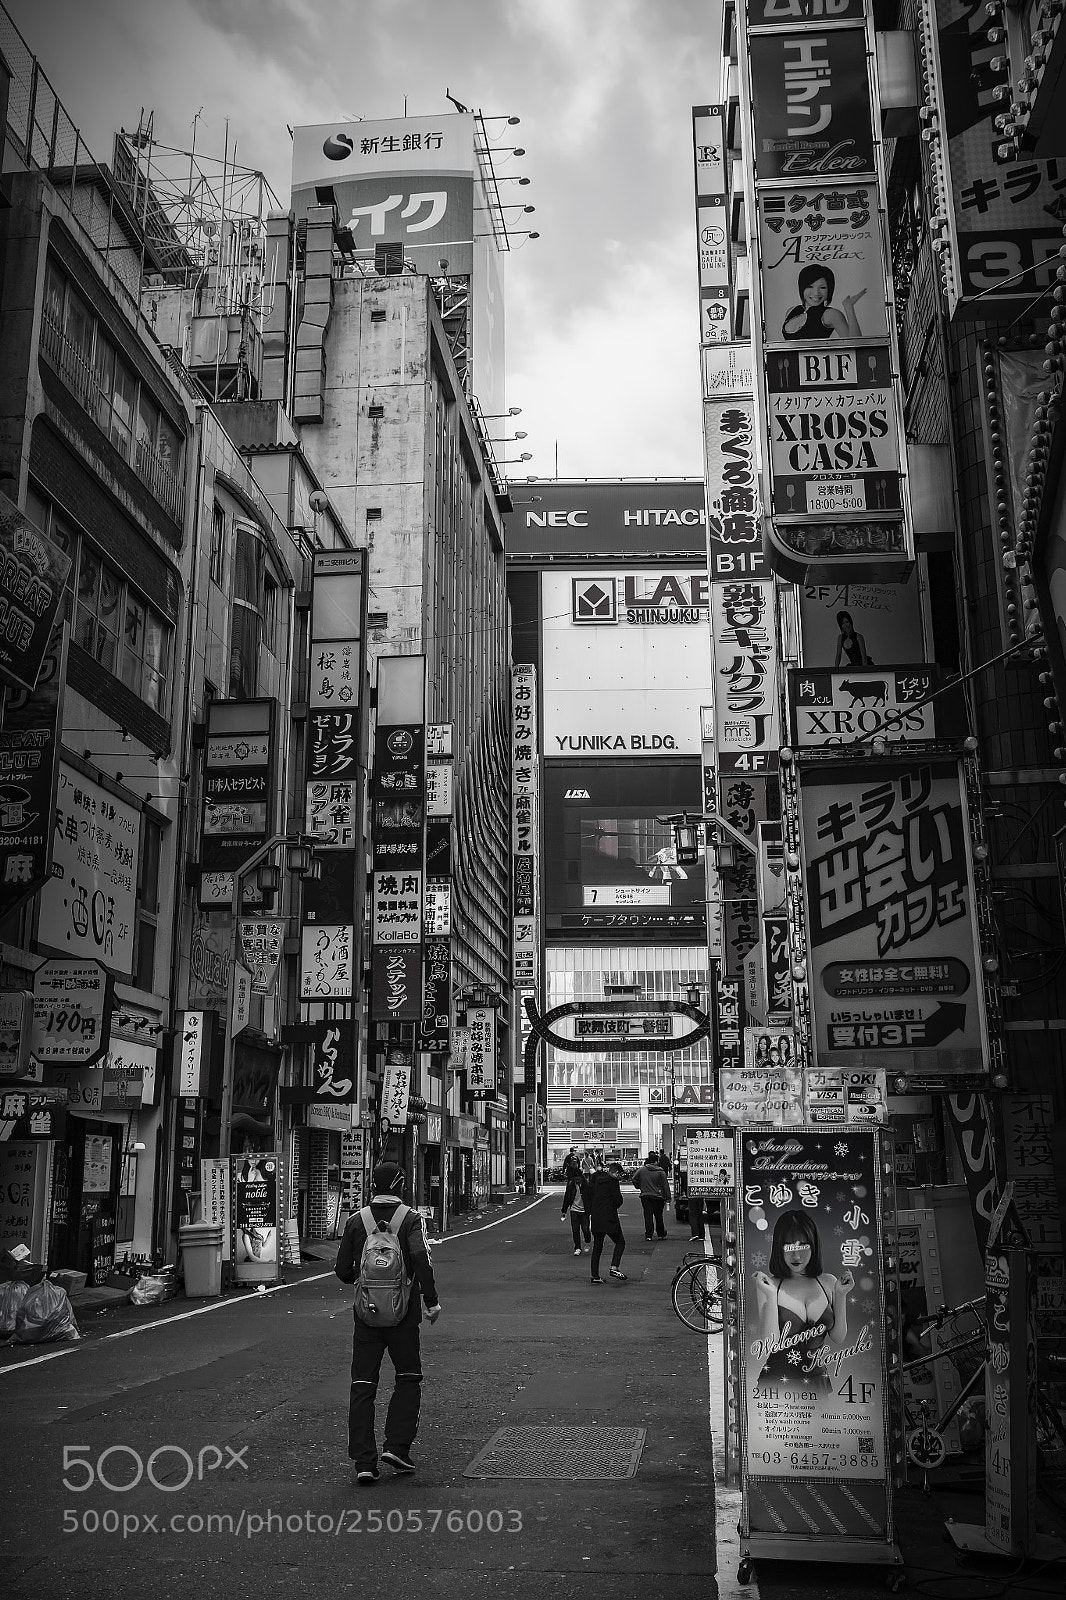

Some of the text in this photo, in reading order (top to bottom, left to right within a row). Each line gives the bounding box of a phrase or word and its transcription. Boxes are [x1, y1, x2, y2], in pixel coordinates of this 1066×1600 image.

[782, 37, 832, 137] エデン
[708, 107, 719, 116] 10
[360, 132, 443, 155] 新生銀行
[780, 138, 868, 174] Eden
[714, 198, 721, 206] 9
[788, 190, 870, 212] タイ古式
[345, 190, 448, 236] イク
[764, 211, 871, 233] マッサージ
[767, 236, 844, 270] Asian
[718, 290, 725, 298] 8
[803, 355, 853, 383] B1F
[775, 409, 889, 443] XROSS
[788, 441, 879, 473] CASA
[719, 408, 757, 544] まぐろ商店
[818, 485, 853, 496] 営業時間
[526, 511, 588, 527] NEC
[317, 558, 359, 567] 第二安田ビル
[716, 552, 766, 574] B1F
[804, 586, 831, 600] 2F
[626, 608, 700, 624] SHINJUKU
[718, 584, 773, 713] 熟女キャバクラ
[316, 652, 337, 700] 桜島
[897, 676, 930, 690] イタリ
[799, 680, 816, 697] 肉
[812, 696, 832, 704] バル
[805, 709, 926, 735] XROSS
[514, 685, 532, 783] お好み焼き
[556, 735, 680, 751] YUNIKA BLDG.
[734, 753, 765, 771] 4F
[208, 777, 266, 793] 日本人セラピスト
[328, 783, 353, 825] 麻雀
[817, 766, 933, 843] キラリ
[210, 814, 253, 827] クアトロ
[329, 828, 353, 845] 2F
[818, 811, 955, 930] 出会い
[377, 875, 419, 896] 焼肉
[377, 900, 419, 911] 韓国料理
[590, 890, 598, 903] 7
[518, 907, 530, 915] 4F
[877, 880, 968, 958] カフェ
[117, 923, 129, 941] 2F
[242, 923, 282, 936] 悪質な
[377, 931, 419, 941] KollaBo
[242, 939, 281, 951] 客引き
[330, 925, 350, 982] 居酒屋
[386, 956, 408, 1011] ステップ
[45, 1010, 97, 1035] 190円
[577, 1019, 670, 1034] 歌舞伎町一番街
[722, 1057, 740, 1068] 2F
[814, 1072, 877, 1085] カードOK!
[473, 1090, 486, 1098] 2F
[816, 1091, 838, 1100] VISA
[2, 1094, 28, 1118] 麻
[30, 1096, 57, 1106] フリー
[30, 1111, 52, 1134] 雀
[245, 1187, 268, 1199] noble
[745, 1183, 821, 1208] こゆき
[840, 1204, 871, 1268] 小雪
[750, 1320, 827, 1360] Welcome
[752, 1387, 819, 1403] 24H open
[838, 1374, 877, 1404] 4F
[762, 1451, 879, 1469] 03-6457-3885
